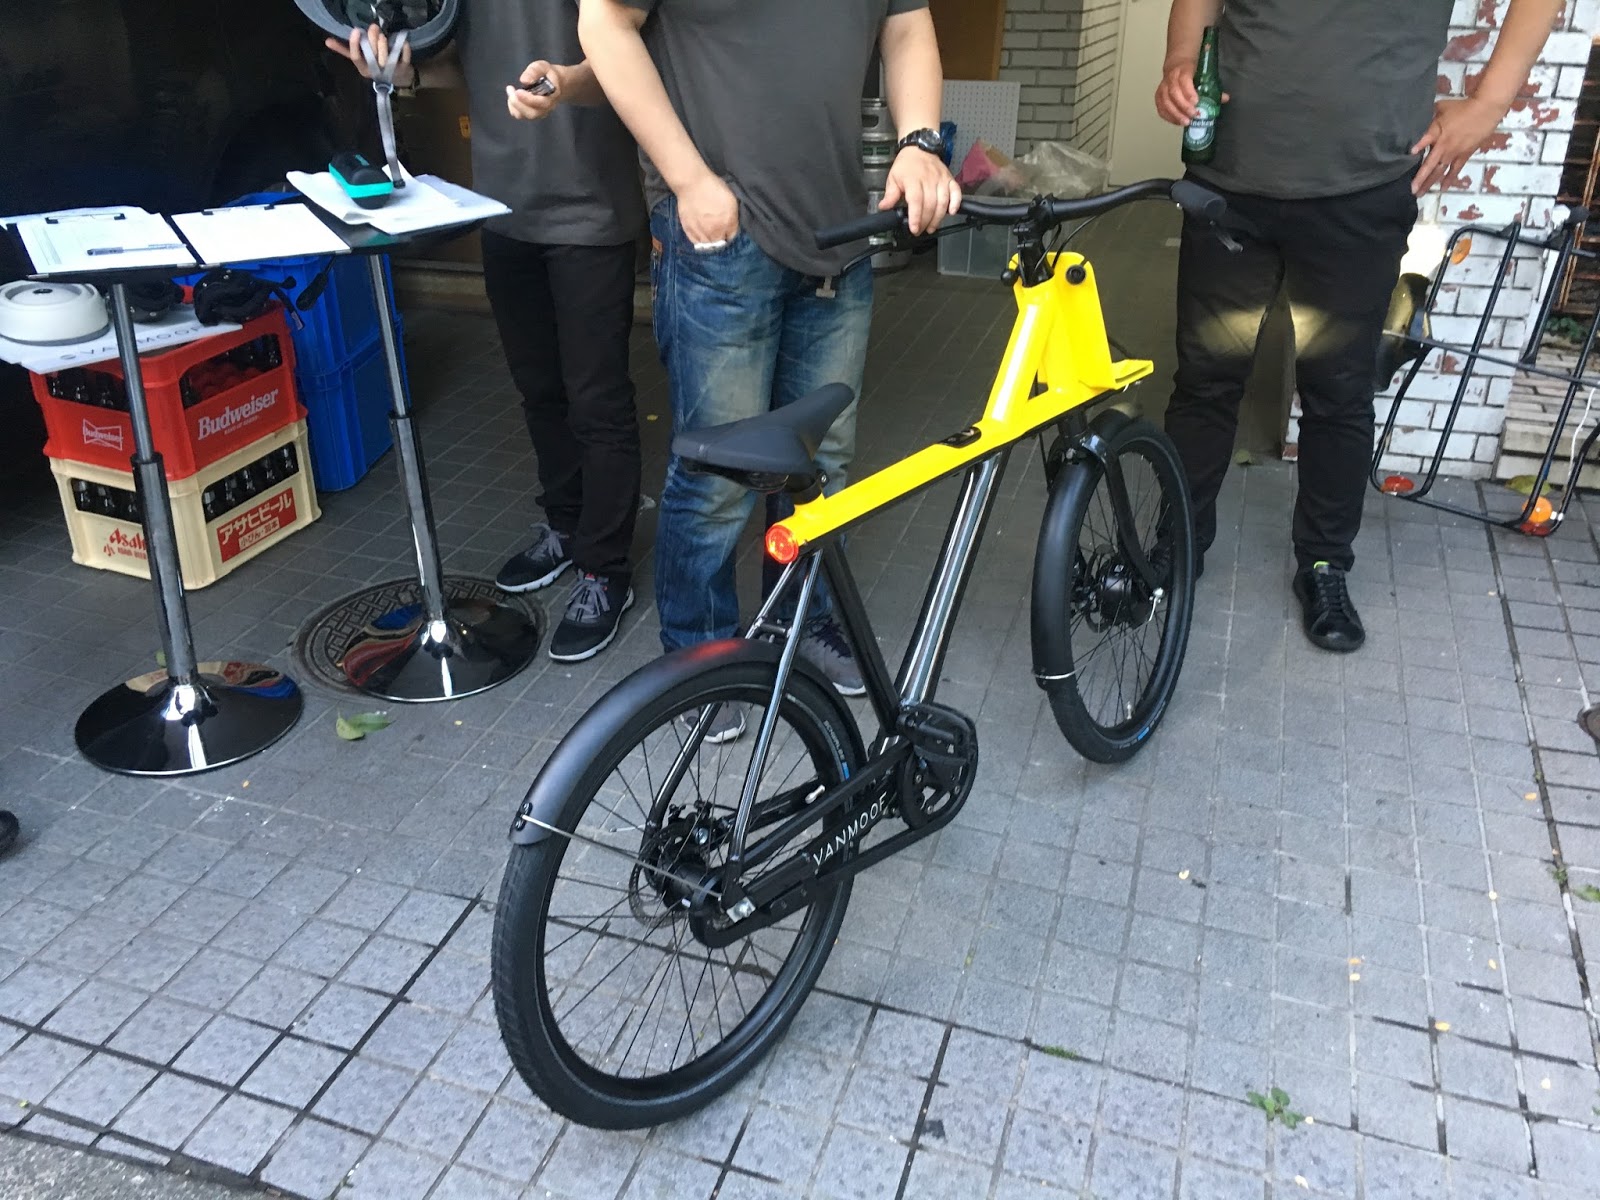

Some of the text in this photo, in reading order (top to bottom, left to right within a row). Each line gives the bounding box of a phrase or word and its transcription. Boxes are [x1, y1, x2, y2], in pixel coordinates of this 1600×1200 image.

[197, 388, 279, 441] Budweiser
[219, 493, 292, 546] アサヒビール
[813, 791, 887, 867] VANMOOF
